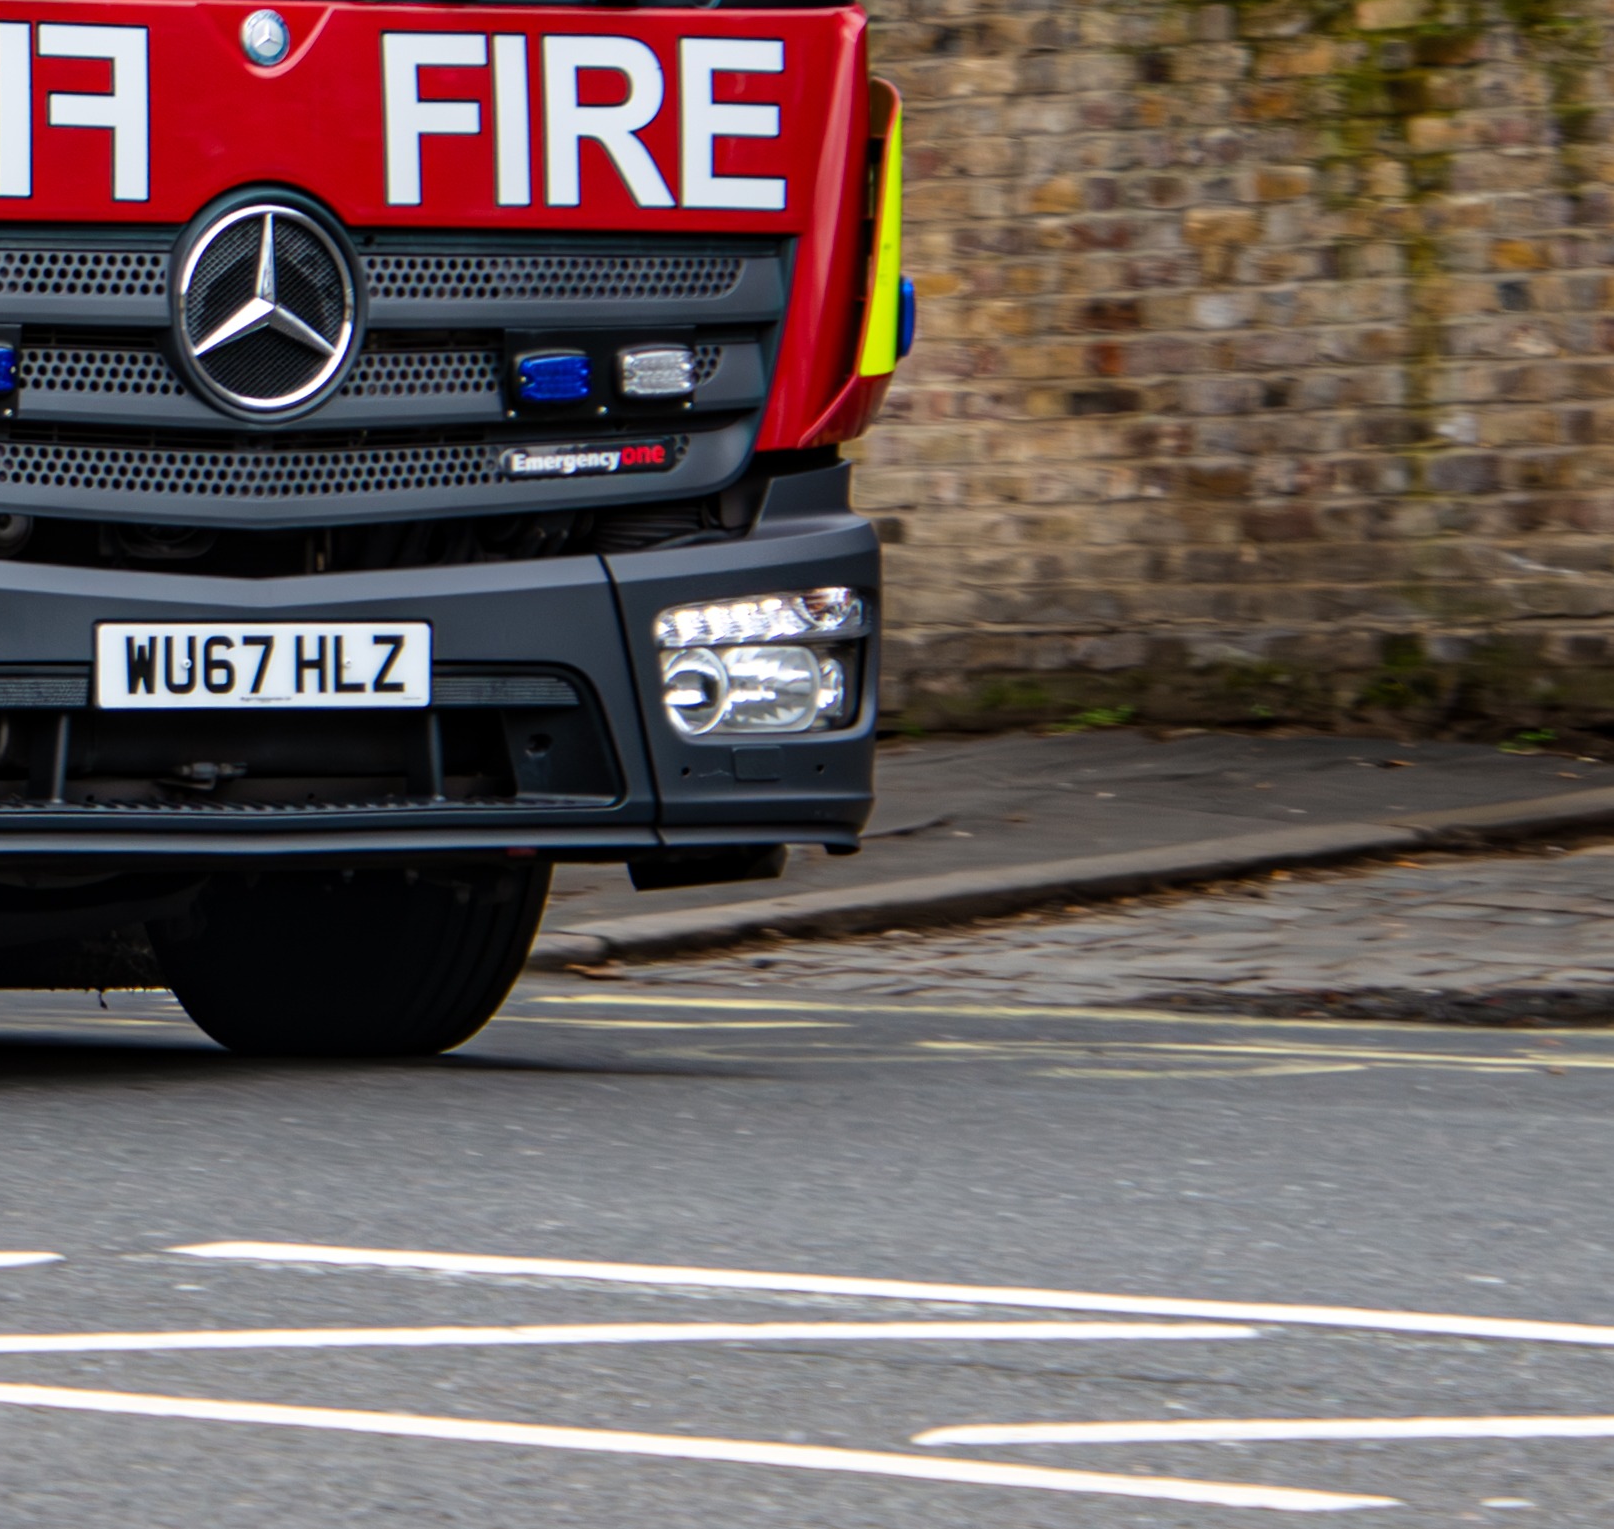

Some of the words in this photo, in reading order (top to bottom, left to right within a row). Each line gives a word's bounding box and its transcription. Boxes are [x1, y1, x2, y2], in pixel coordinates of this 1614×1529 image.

[381, 30, 787, 212] FIRE
[125, 634, 275, 696] WU67
[294, 634, 406, 695] HLZ
